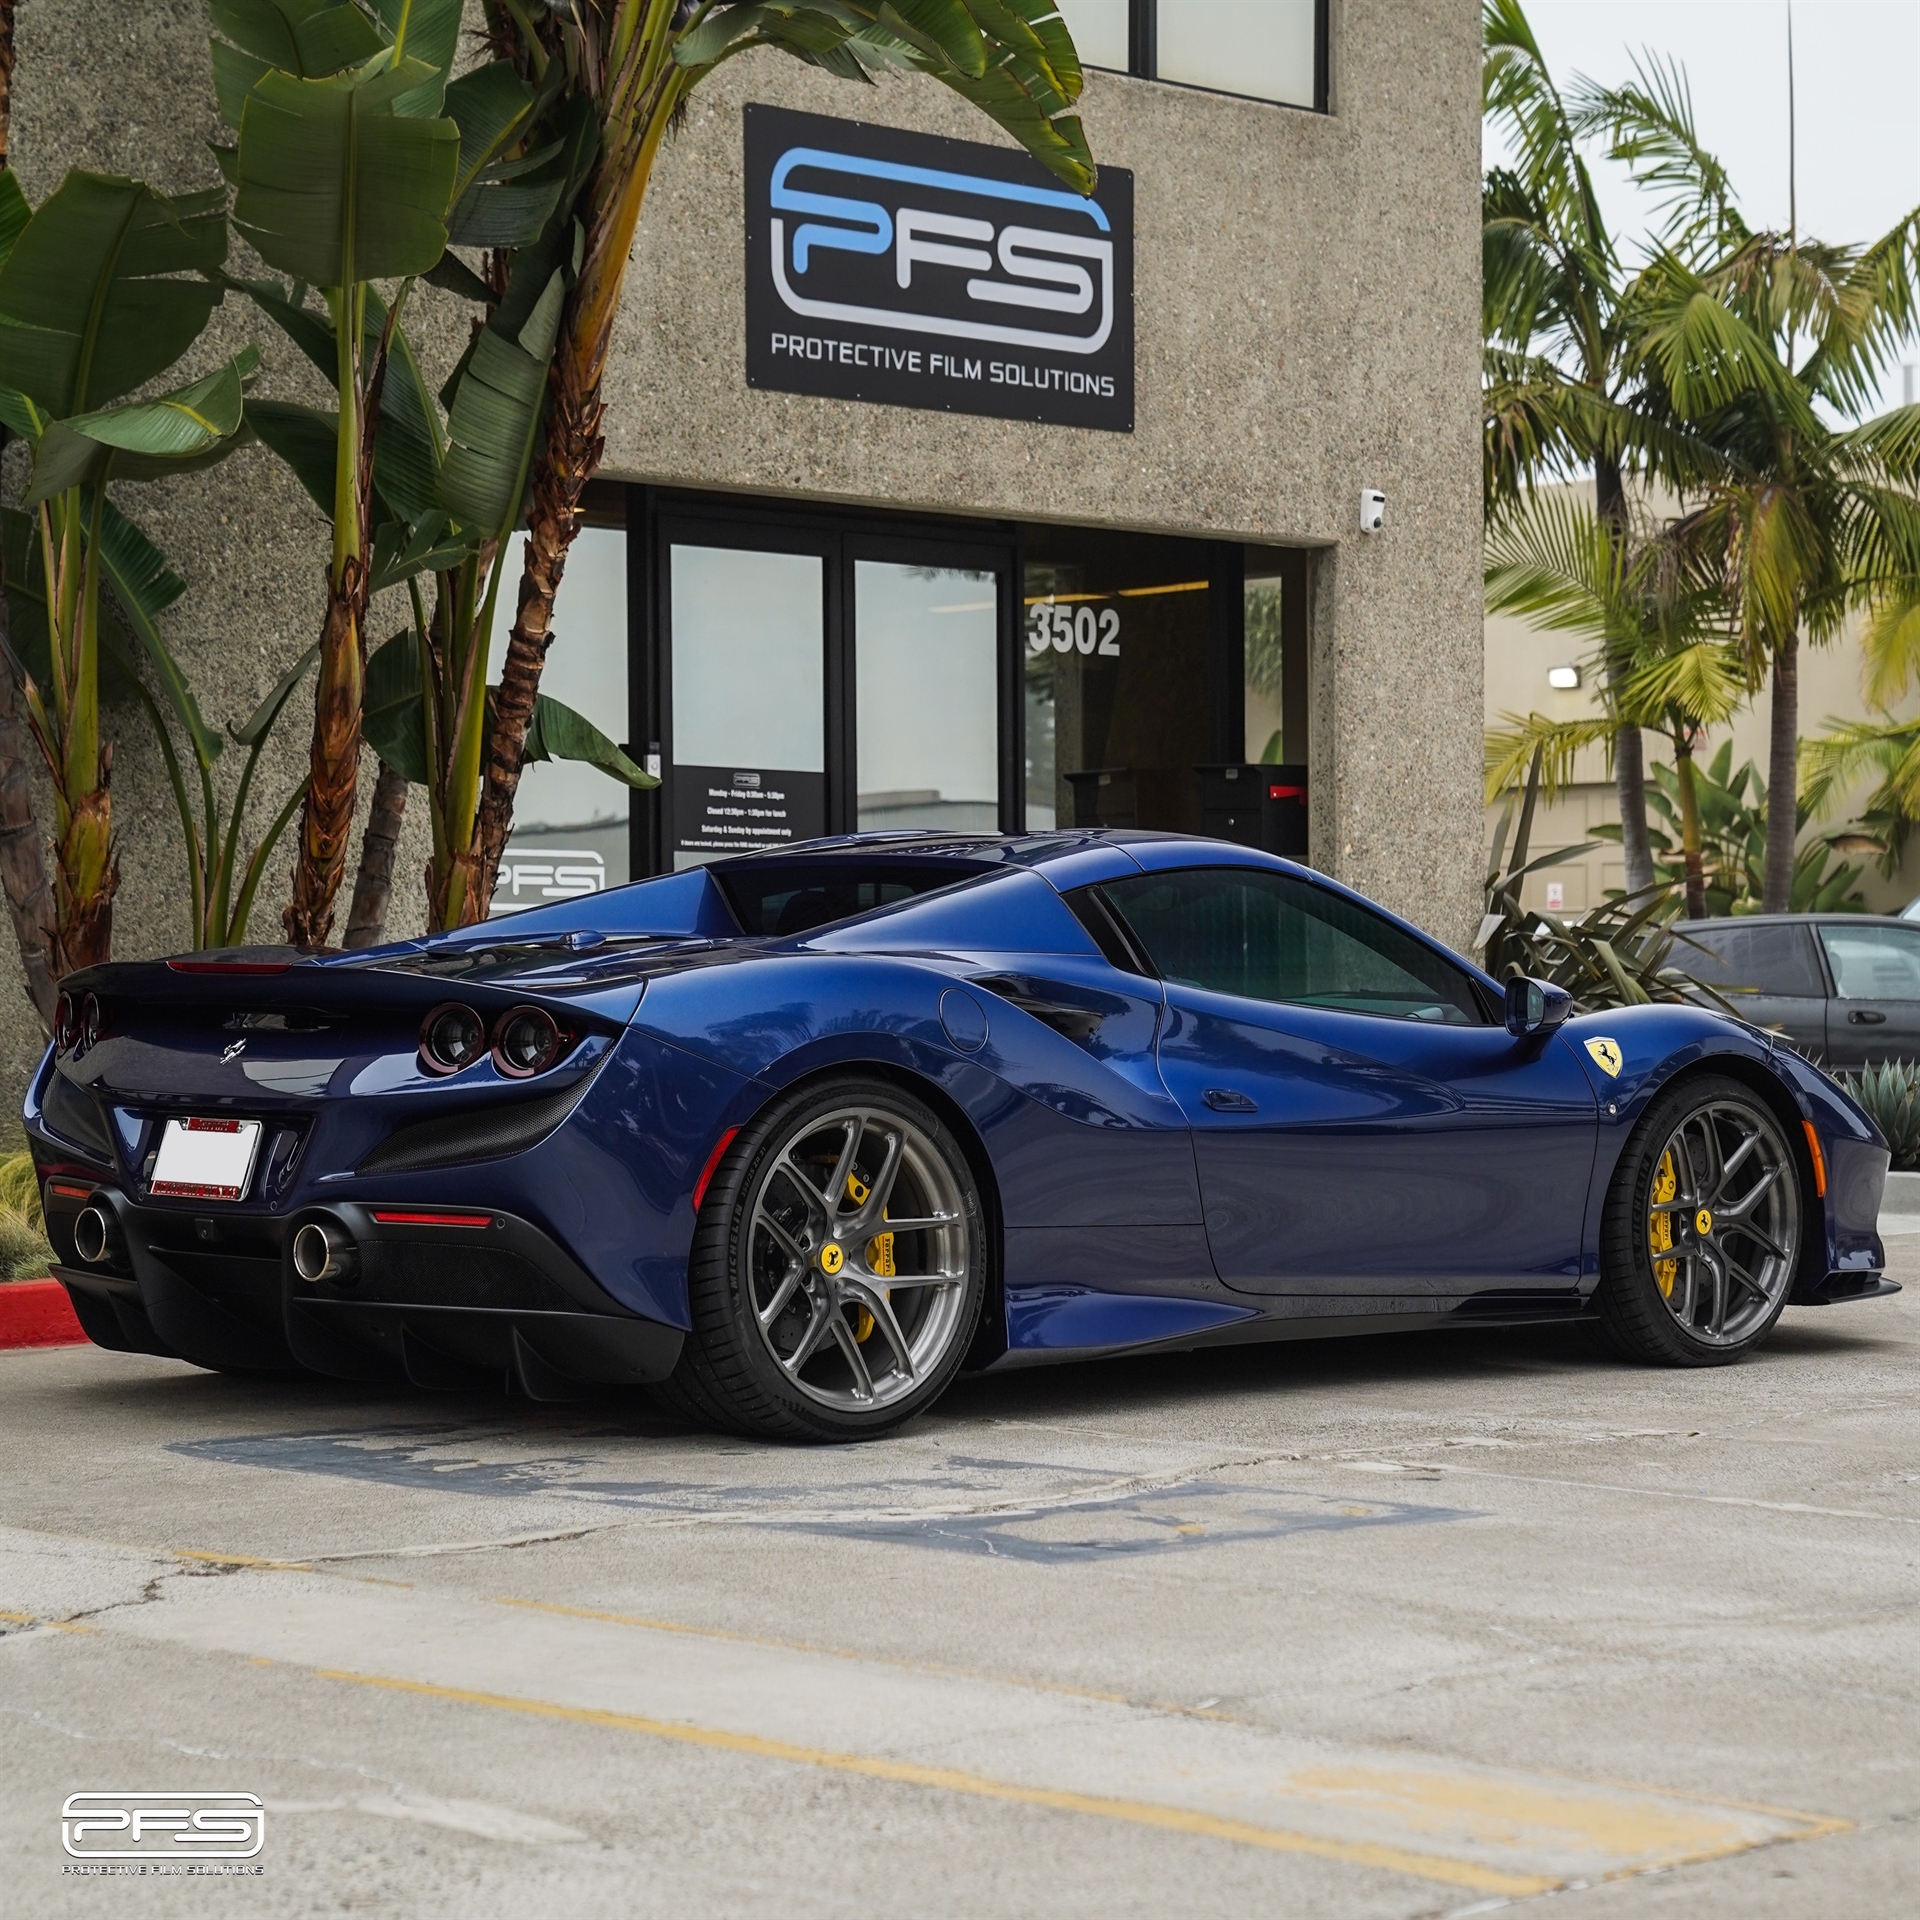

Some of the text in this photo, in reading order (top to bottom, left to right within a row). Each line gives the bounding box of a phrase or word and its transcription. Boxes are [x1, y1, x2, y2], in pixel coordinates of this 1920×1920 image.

[770, 186, 1113, 316] PFS
[771, 332, 1115, 397] PROTECTIVE FILM SOLUTIONS
[1028, 603, 1120, 656] 3502
[707, 806, 724, 815] Closed
[772, 810, 787, 818] lunch
[708, 788, 728, 798] Monday
[730, 789, 746, 799] Friday
[701, 824, 792, 837] Saturday & Sunday by appointment only
[1633, 1158, 1651, 1245] MICHELIN
[729, 1204, 743, 1290] MICHELIN
